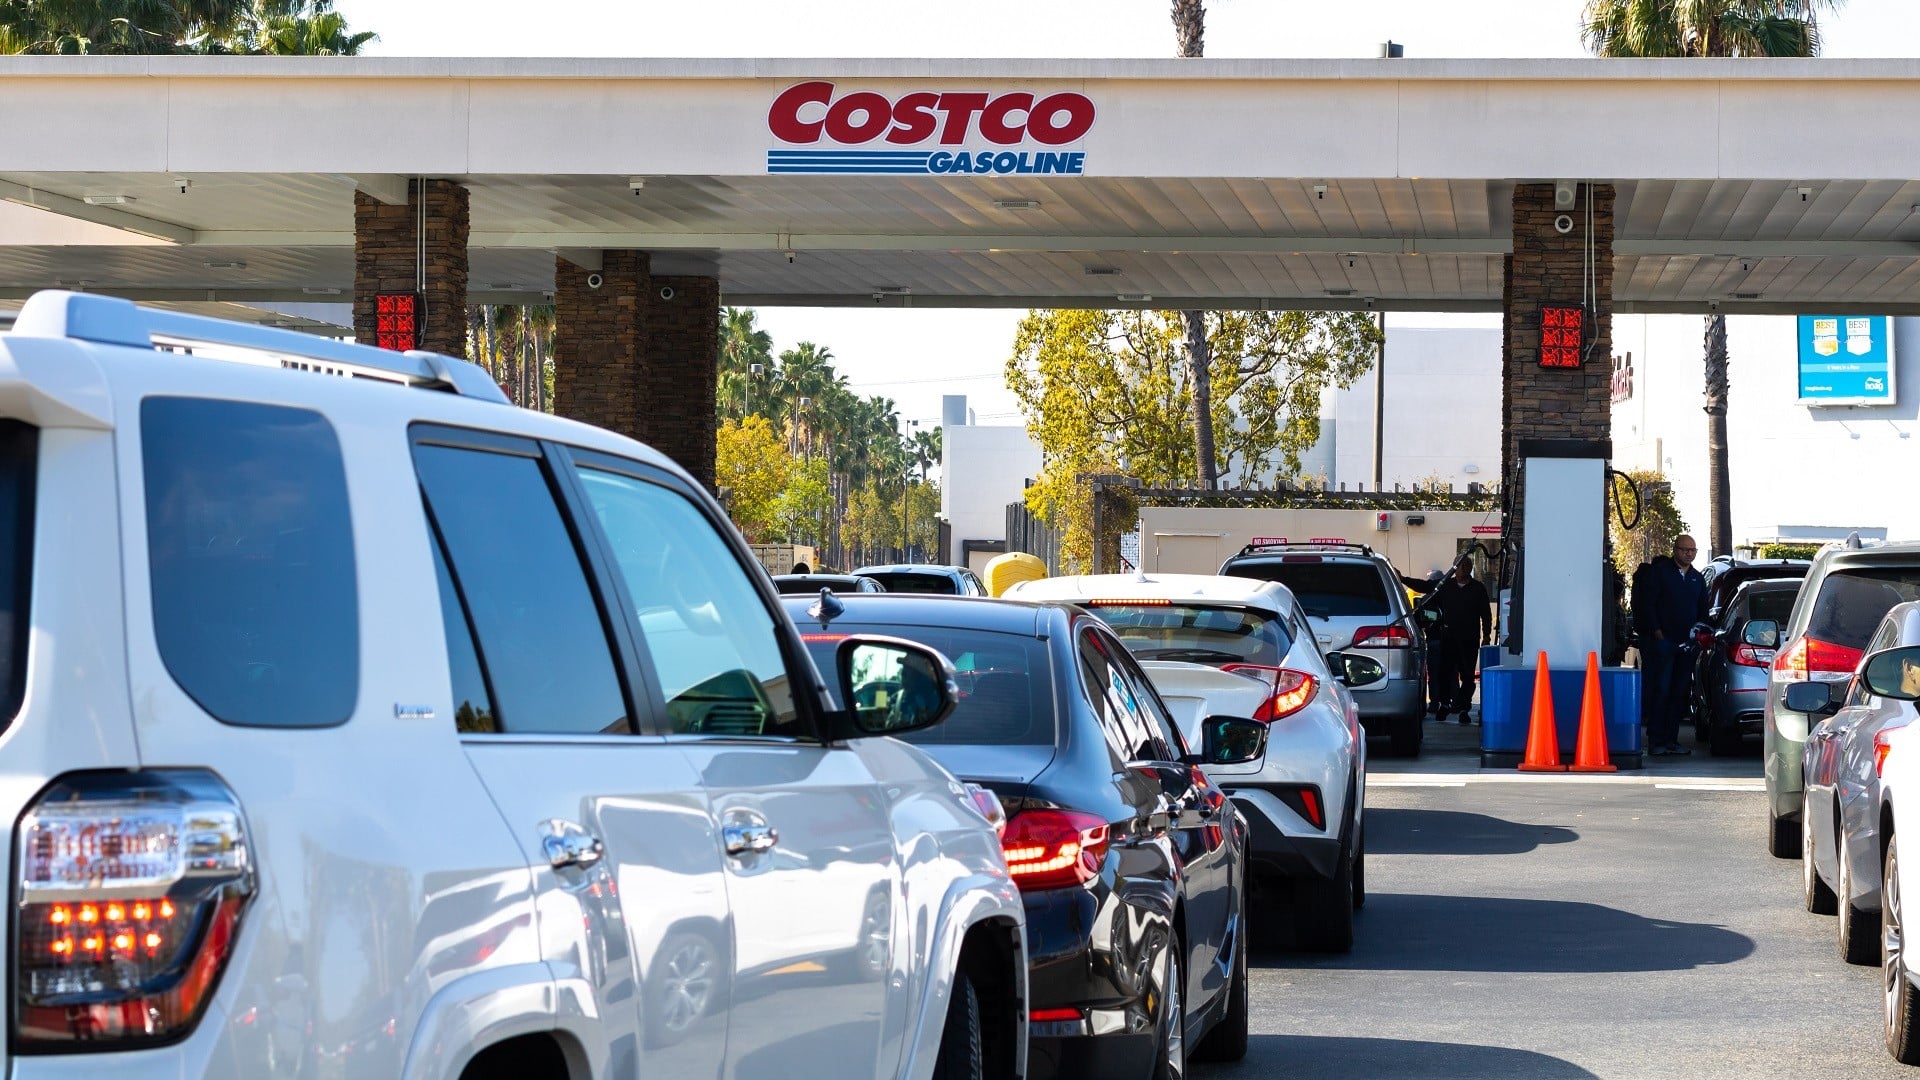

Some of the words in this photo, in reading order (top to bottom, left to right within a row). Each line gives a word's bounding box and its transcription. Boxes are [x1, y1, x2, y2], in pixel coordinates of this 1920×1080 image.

[768, 81, 1096, 145] COSTCO
[928, 151, 1086, 174] GASOLINE
[1816, 321, 1836, 329] BEST
[1848, 320, 1868, 329] BEST
